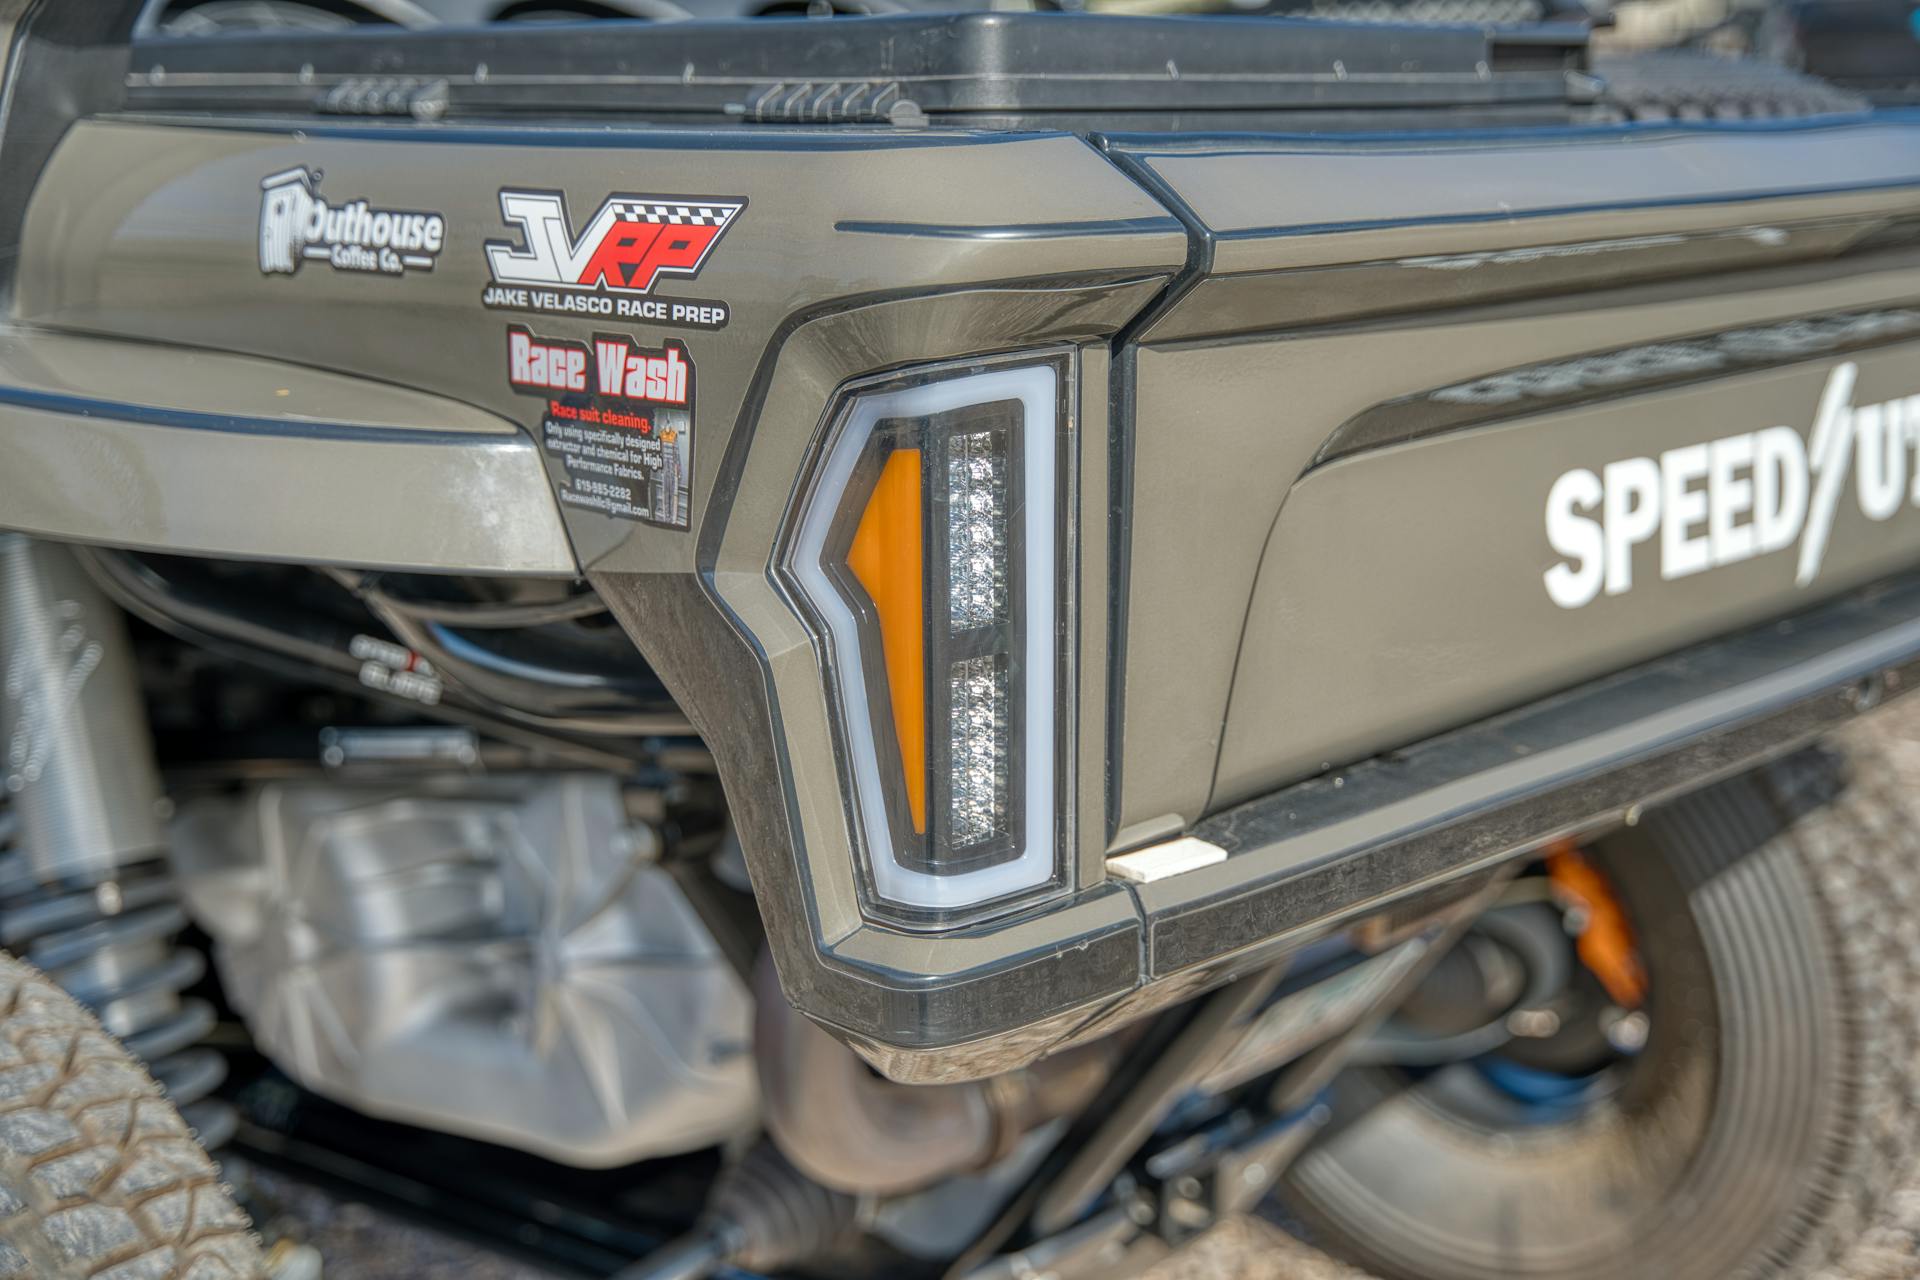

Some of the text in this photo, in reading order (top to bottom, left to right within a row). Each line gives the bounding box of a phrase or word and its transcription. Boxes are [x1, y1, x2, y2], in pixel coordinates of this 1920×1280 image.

[305, 200, 443, 251] Outhouse
[330, 245, 403, 272] Coffee Co.
[484, 287, 725, 324] JAKE VELASCO RACE PREP
[510, 331, 688, 404] Race Wash
[550, 400, 651, 433] Race suit cleaning.
[545, 420, 660, 451] Only using specifically designed
[566, 454, 644, 480] Performance Fabrics.
[582, 442, 595, 455] and
[597, 446, 628, 462] chemical
[630, 450, 642, 464] for
[643, 452, 663, 470] High
[1544, 425, 1809, 609] SPEED
